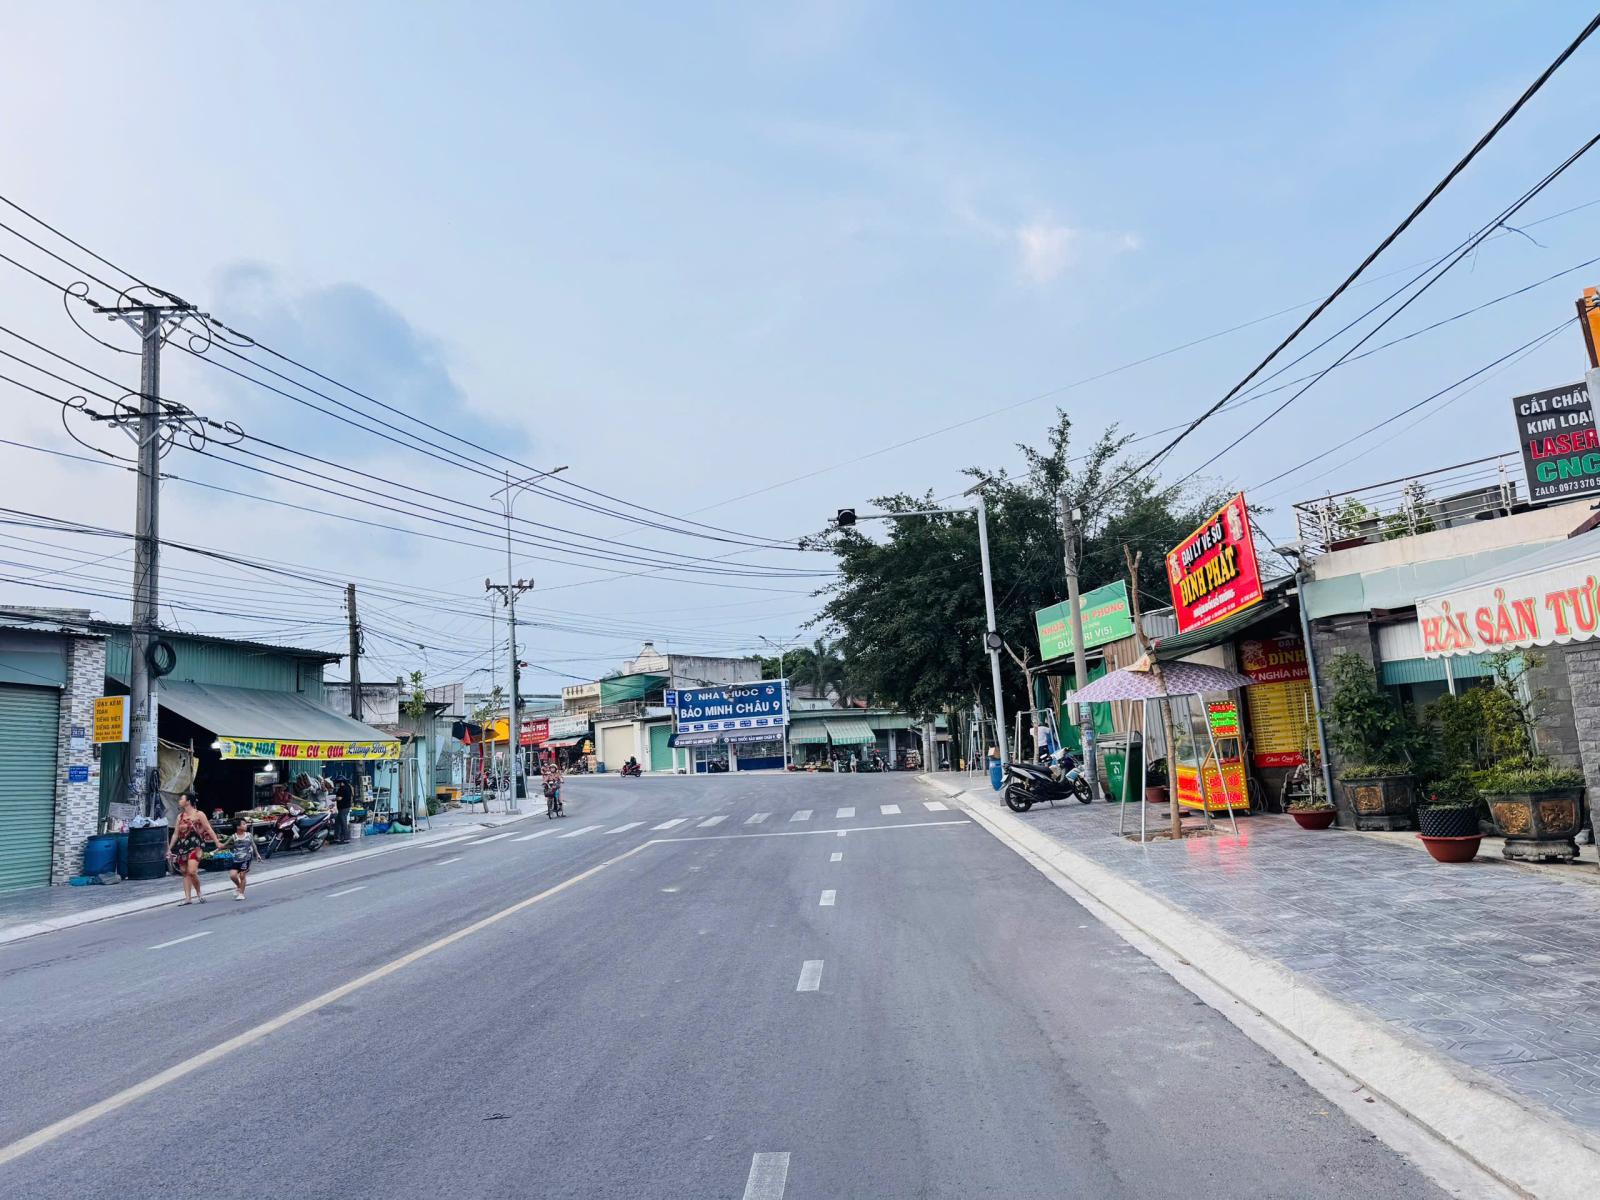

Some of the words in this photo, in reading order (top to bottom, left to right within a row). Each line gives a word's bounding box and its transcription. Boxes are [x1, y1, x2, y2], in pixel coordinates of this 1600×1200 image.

[1520, 396, 1547, 416] CẮT
[1527, 418, 1556, 434] KIM
[1560, 410, 1594, 428] LOẠI
[1530, 428, 1600, 460] LASER
[1536, 452, 1600, 483] CNC
[1535, 485, 1558, 496] ZALO:
[1559, 480, 1579, 493] 0973
[1211, 515, 1222, 544] SỐ
[1205, 542, 1236, 591] PHÁT
[1421, 600, 1475, 653] HẢI
[1475, 587, 1541, 646] SẢN
[1545, 574, 1600, 636] TƯ
[680, 704, 702, 719] BẢO
[704, 705, 733, 717] MINH
[735, 700, 770, 714] CHÂU
[772, 700, 780, 711] 9
[279, 743, 299, 758] RAU
